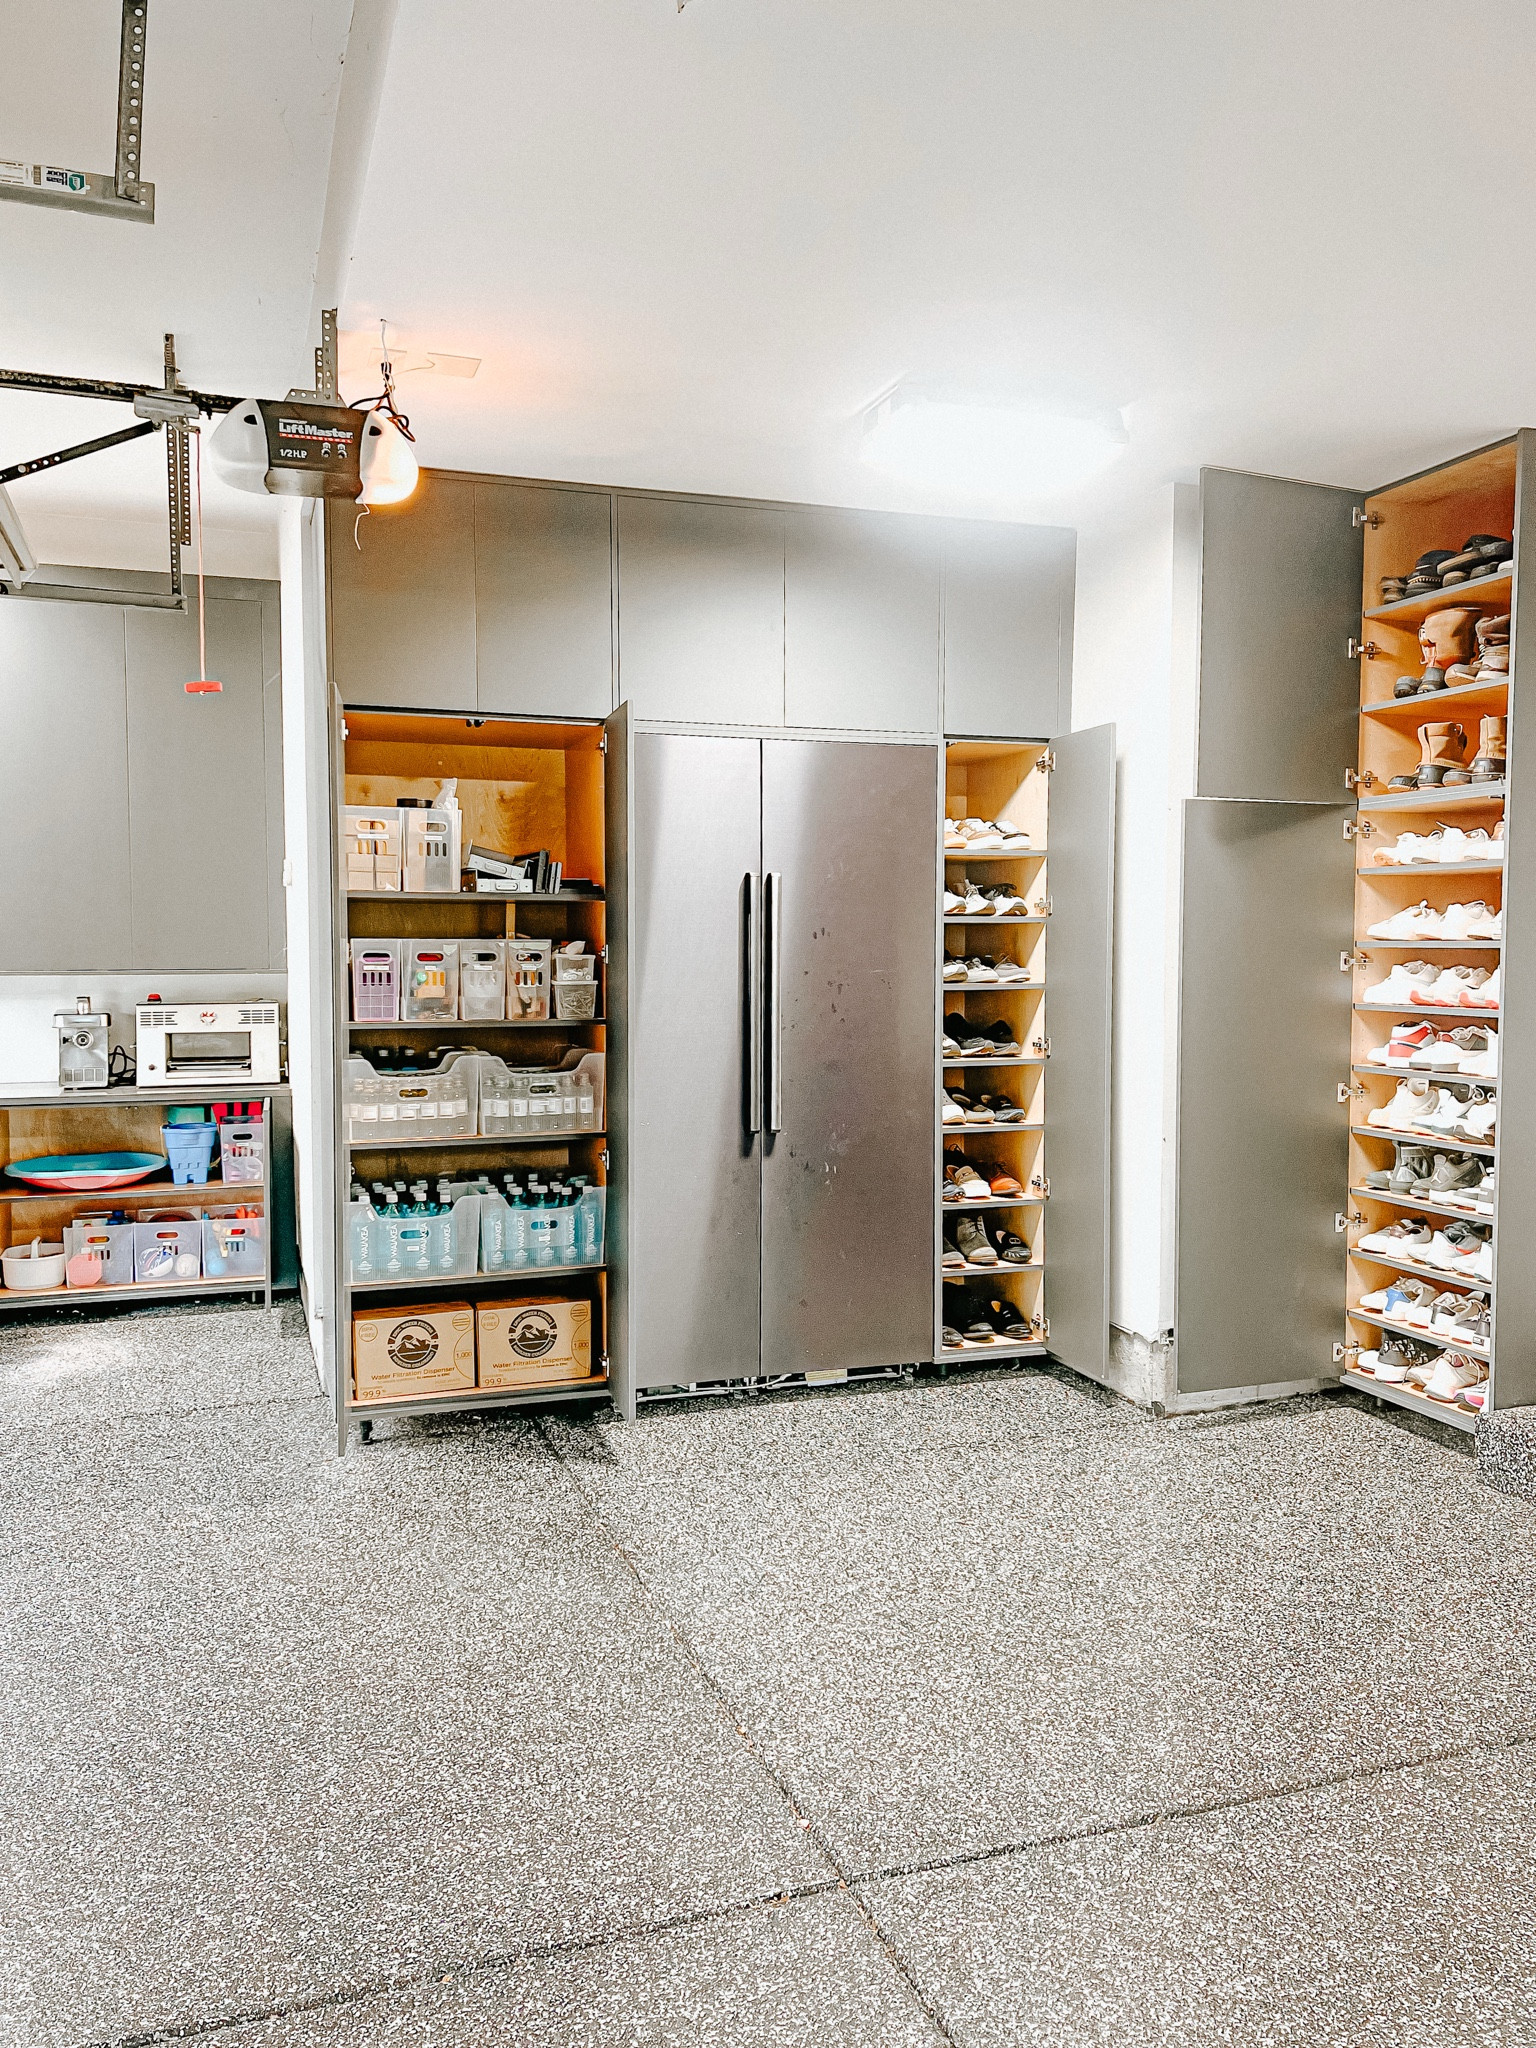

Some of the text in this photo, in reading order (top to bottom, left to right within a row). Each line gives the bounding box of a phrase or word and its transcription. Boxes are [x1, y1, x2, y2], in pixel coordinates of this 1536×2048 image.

[46, 170, 68, 178] Door
[279, 422, 353, 439] LiftMaster
[280, 449, 292, 457] 1/2
[392, 1370, 422, 1379] Filtration
[423, 1367, 455, 1375] Dispenser
[484, 1378, 502, 1386] 99.9
[362, 1389, 381, 1398] 99.9
